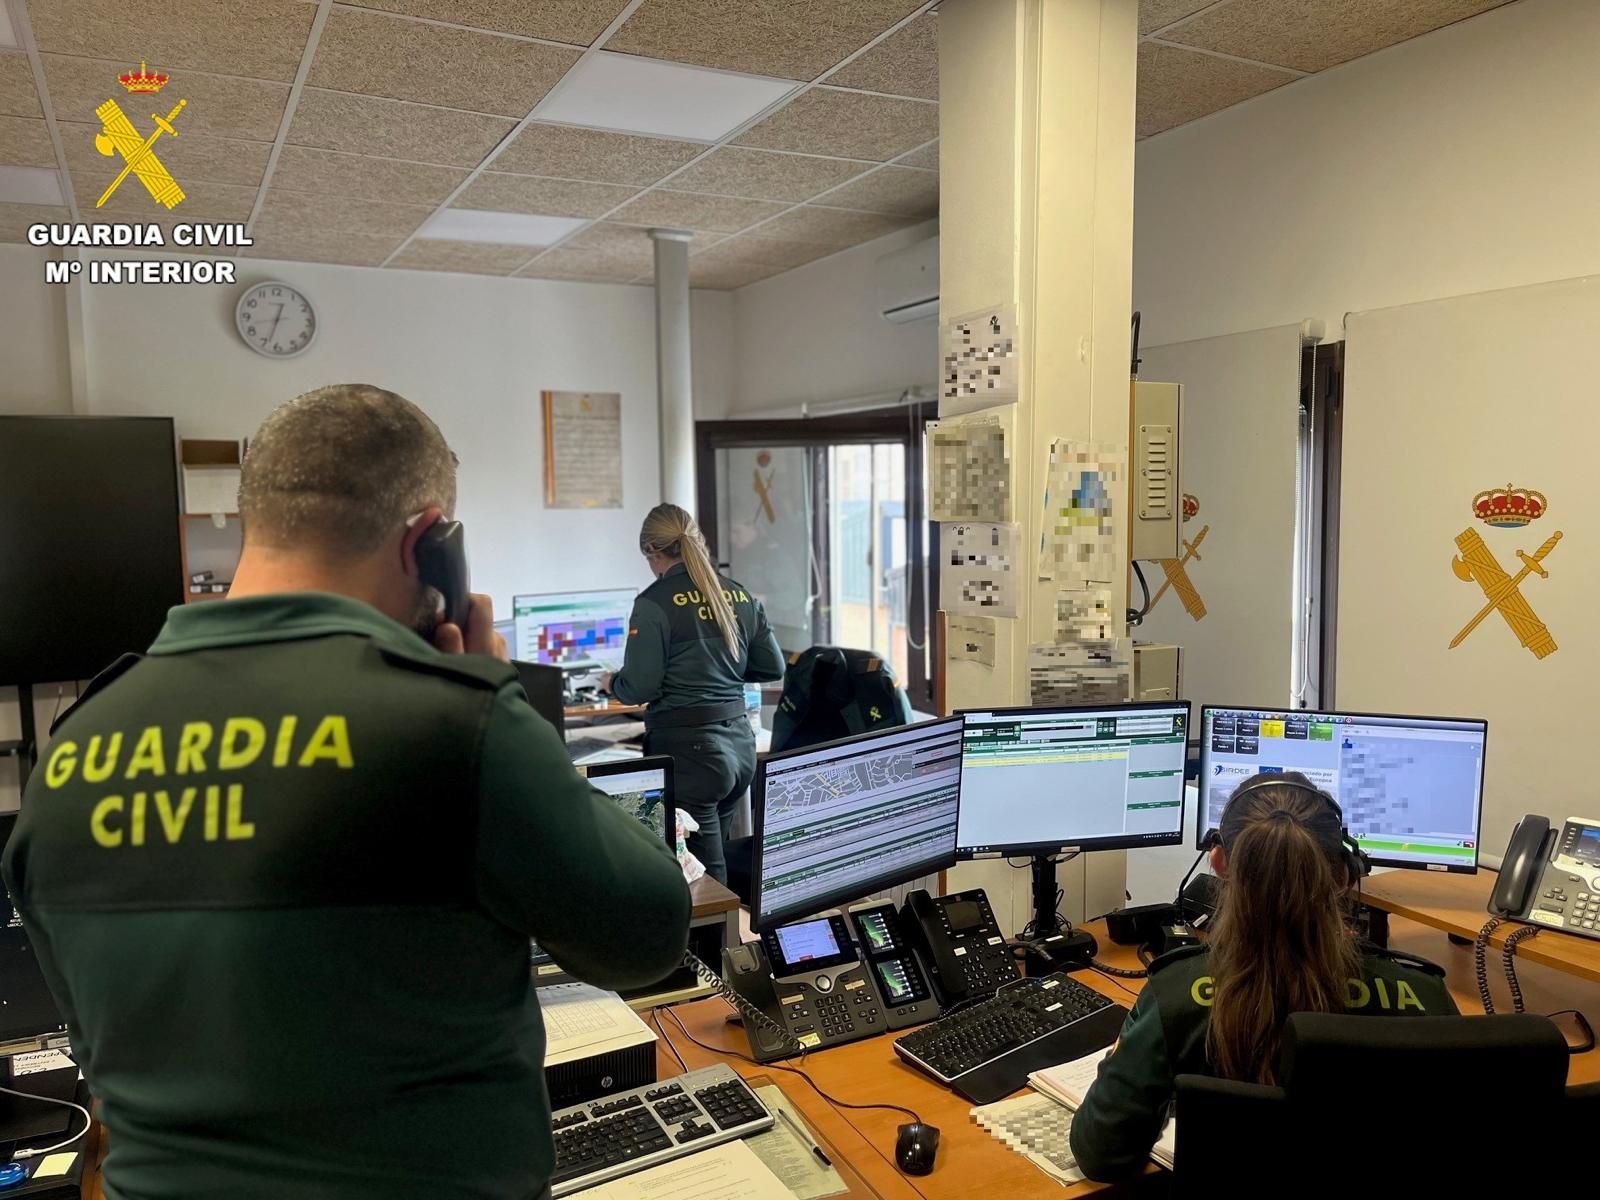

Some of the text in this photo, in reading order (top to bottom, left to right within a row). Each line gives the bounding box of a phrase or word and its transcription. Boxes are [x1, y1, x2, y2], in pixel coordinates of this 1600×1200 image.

[247, 325, 256, 337] 8
[672, 590, 749, 606] GUDIA
[45, 714, 354, 789] GUARDIA
[90, 784, 255, 848] CIVIL
[1191, 976, 1425, 1011] GDIA
